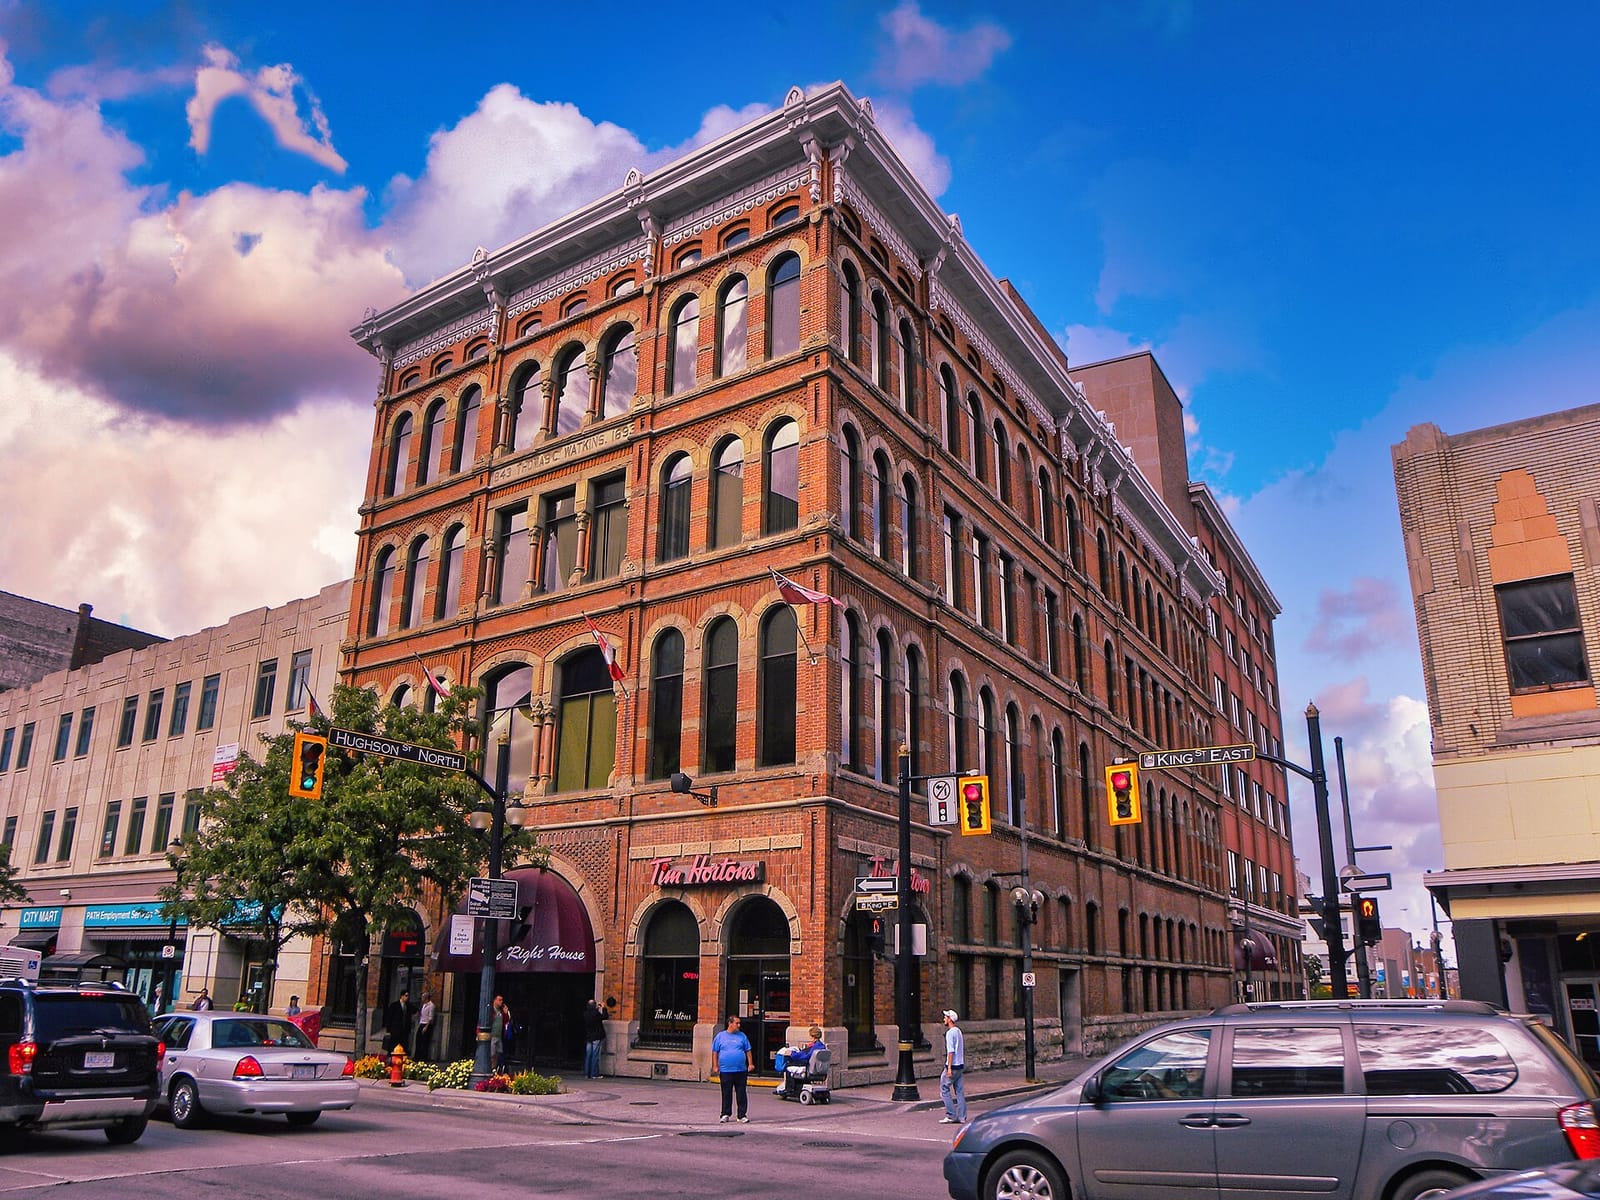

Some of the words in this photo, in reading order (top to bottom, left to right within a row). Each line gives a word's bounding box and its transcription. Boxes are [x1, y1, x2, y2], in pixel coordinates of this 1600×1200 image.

[335, 731, 400, 756] HUGHSON
[418, 748, 460, 768] NORTH
[1157, 753, 1194, 767] KING
[1210, 748, 1250, 762] EAST
[650, 857, 682, 886] Tim
[684, 855, 757, 885] Hortons
[866, 901, 882, 909] KING
[23, 911, 38, 923] CITY
[39, 910, 59, 922] MART
[86, 910, 100, 920] PATH
[100, 910, 131, 922] Employment
[506, 944, 545, 965] Right
[547, 945, 586, 961] House
[665, 1009, 692, 1021] Hrtons
